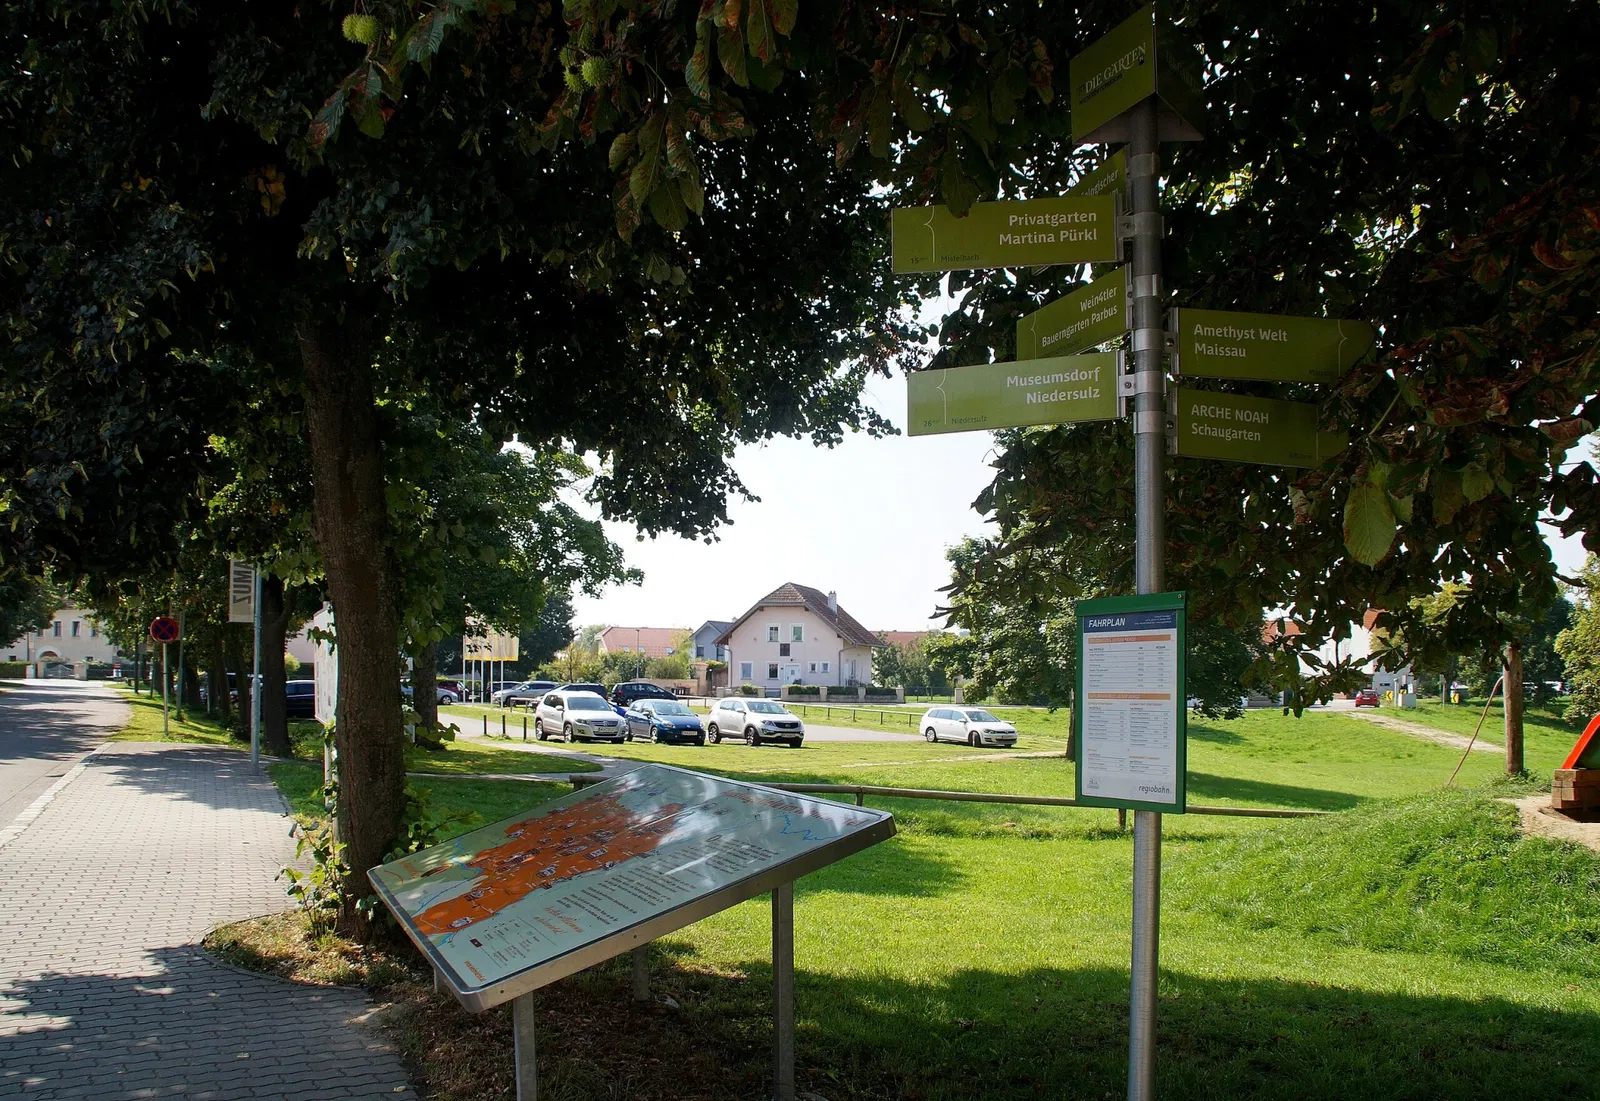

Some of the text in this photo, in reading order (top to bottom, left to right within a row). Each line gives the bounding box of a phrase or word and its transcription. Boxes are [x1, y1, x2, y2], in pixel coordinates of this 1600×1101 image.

[1085, 73, 1102, 94] DIE
[1009, 211, 1097, 228] Privatgarten
[1000, 228, 1098, 246] Martina Pürkl
[940, 254, 980, 263] Mistelbach
[1042, 317, 1090, 347] Bauerngarten
[1194, 323, 1288, 342] Amethyst Welt
[1194, 343, 1247, 357] Maissau
[1007, 366, 1101, 388] Museumsdorf
[1026, 388, 1100, 405] Niedersulz
[951, 415, 987, 425] Niedersulz
[1191, 404, 1269, 424] ARCHE NOAH
[1191, 422, 1261, 441] Schaugarten
[1088, 617, 1126, 628] FAHRPLAN
[1138, 784, 1170, 795] regiobahn
